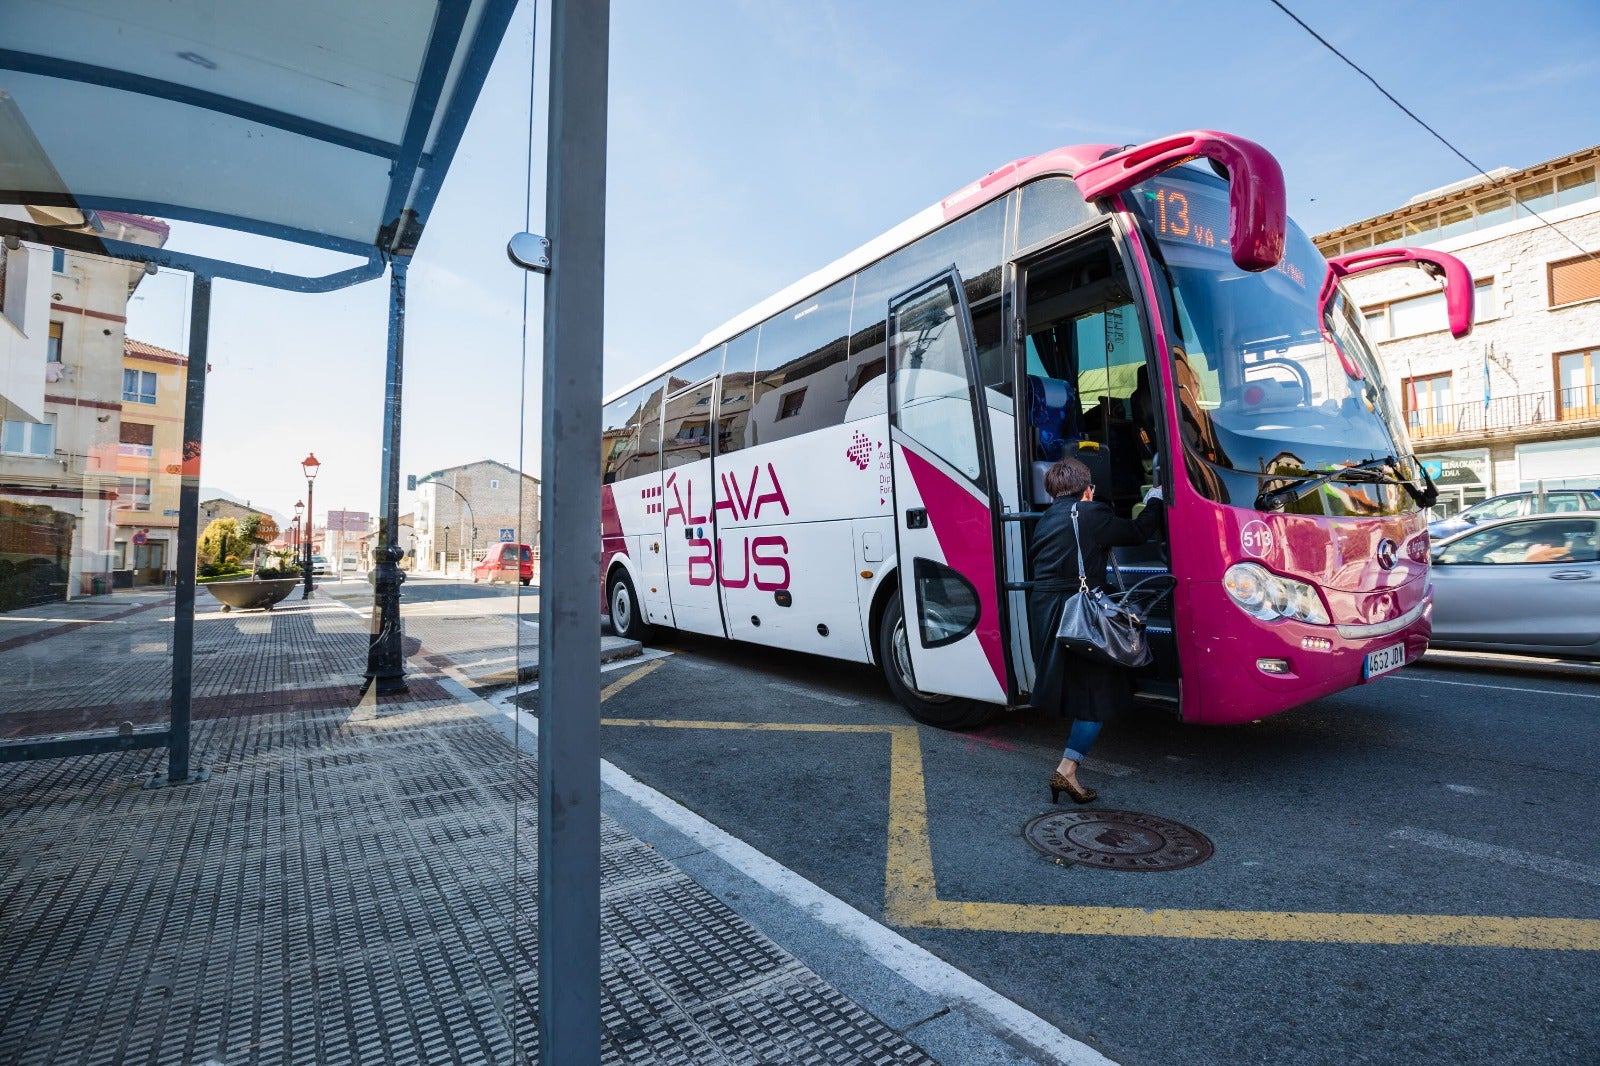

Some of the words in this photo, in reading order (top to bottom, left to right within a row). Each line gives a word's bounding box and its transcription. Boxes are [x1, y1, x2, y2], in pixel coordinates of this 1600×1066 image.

[1157, 190, 1190, 236] 13
[879, 451, 891, 460] Ara
[879, 461, 891, 470] Ald
[880, 475, 891, 484] Dip
[665, 462, 790, 528] ÁLAVA
[688, 535, 791, 592] BUS
[1369, 651, 1389, 672] 4652
